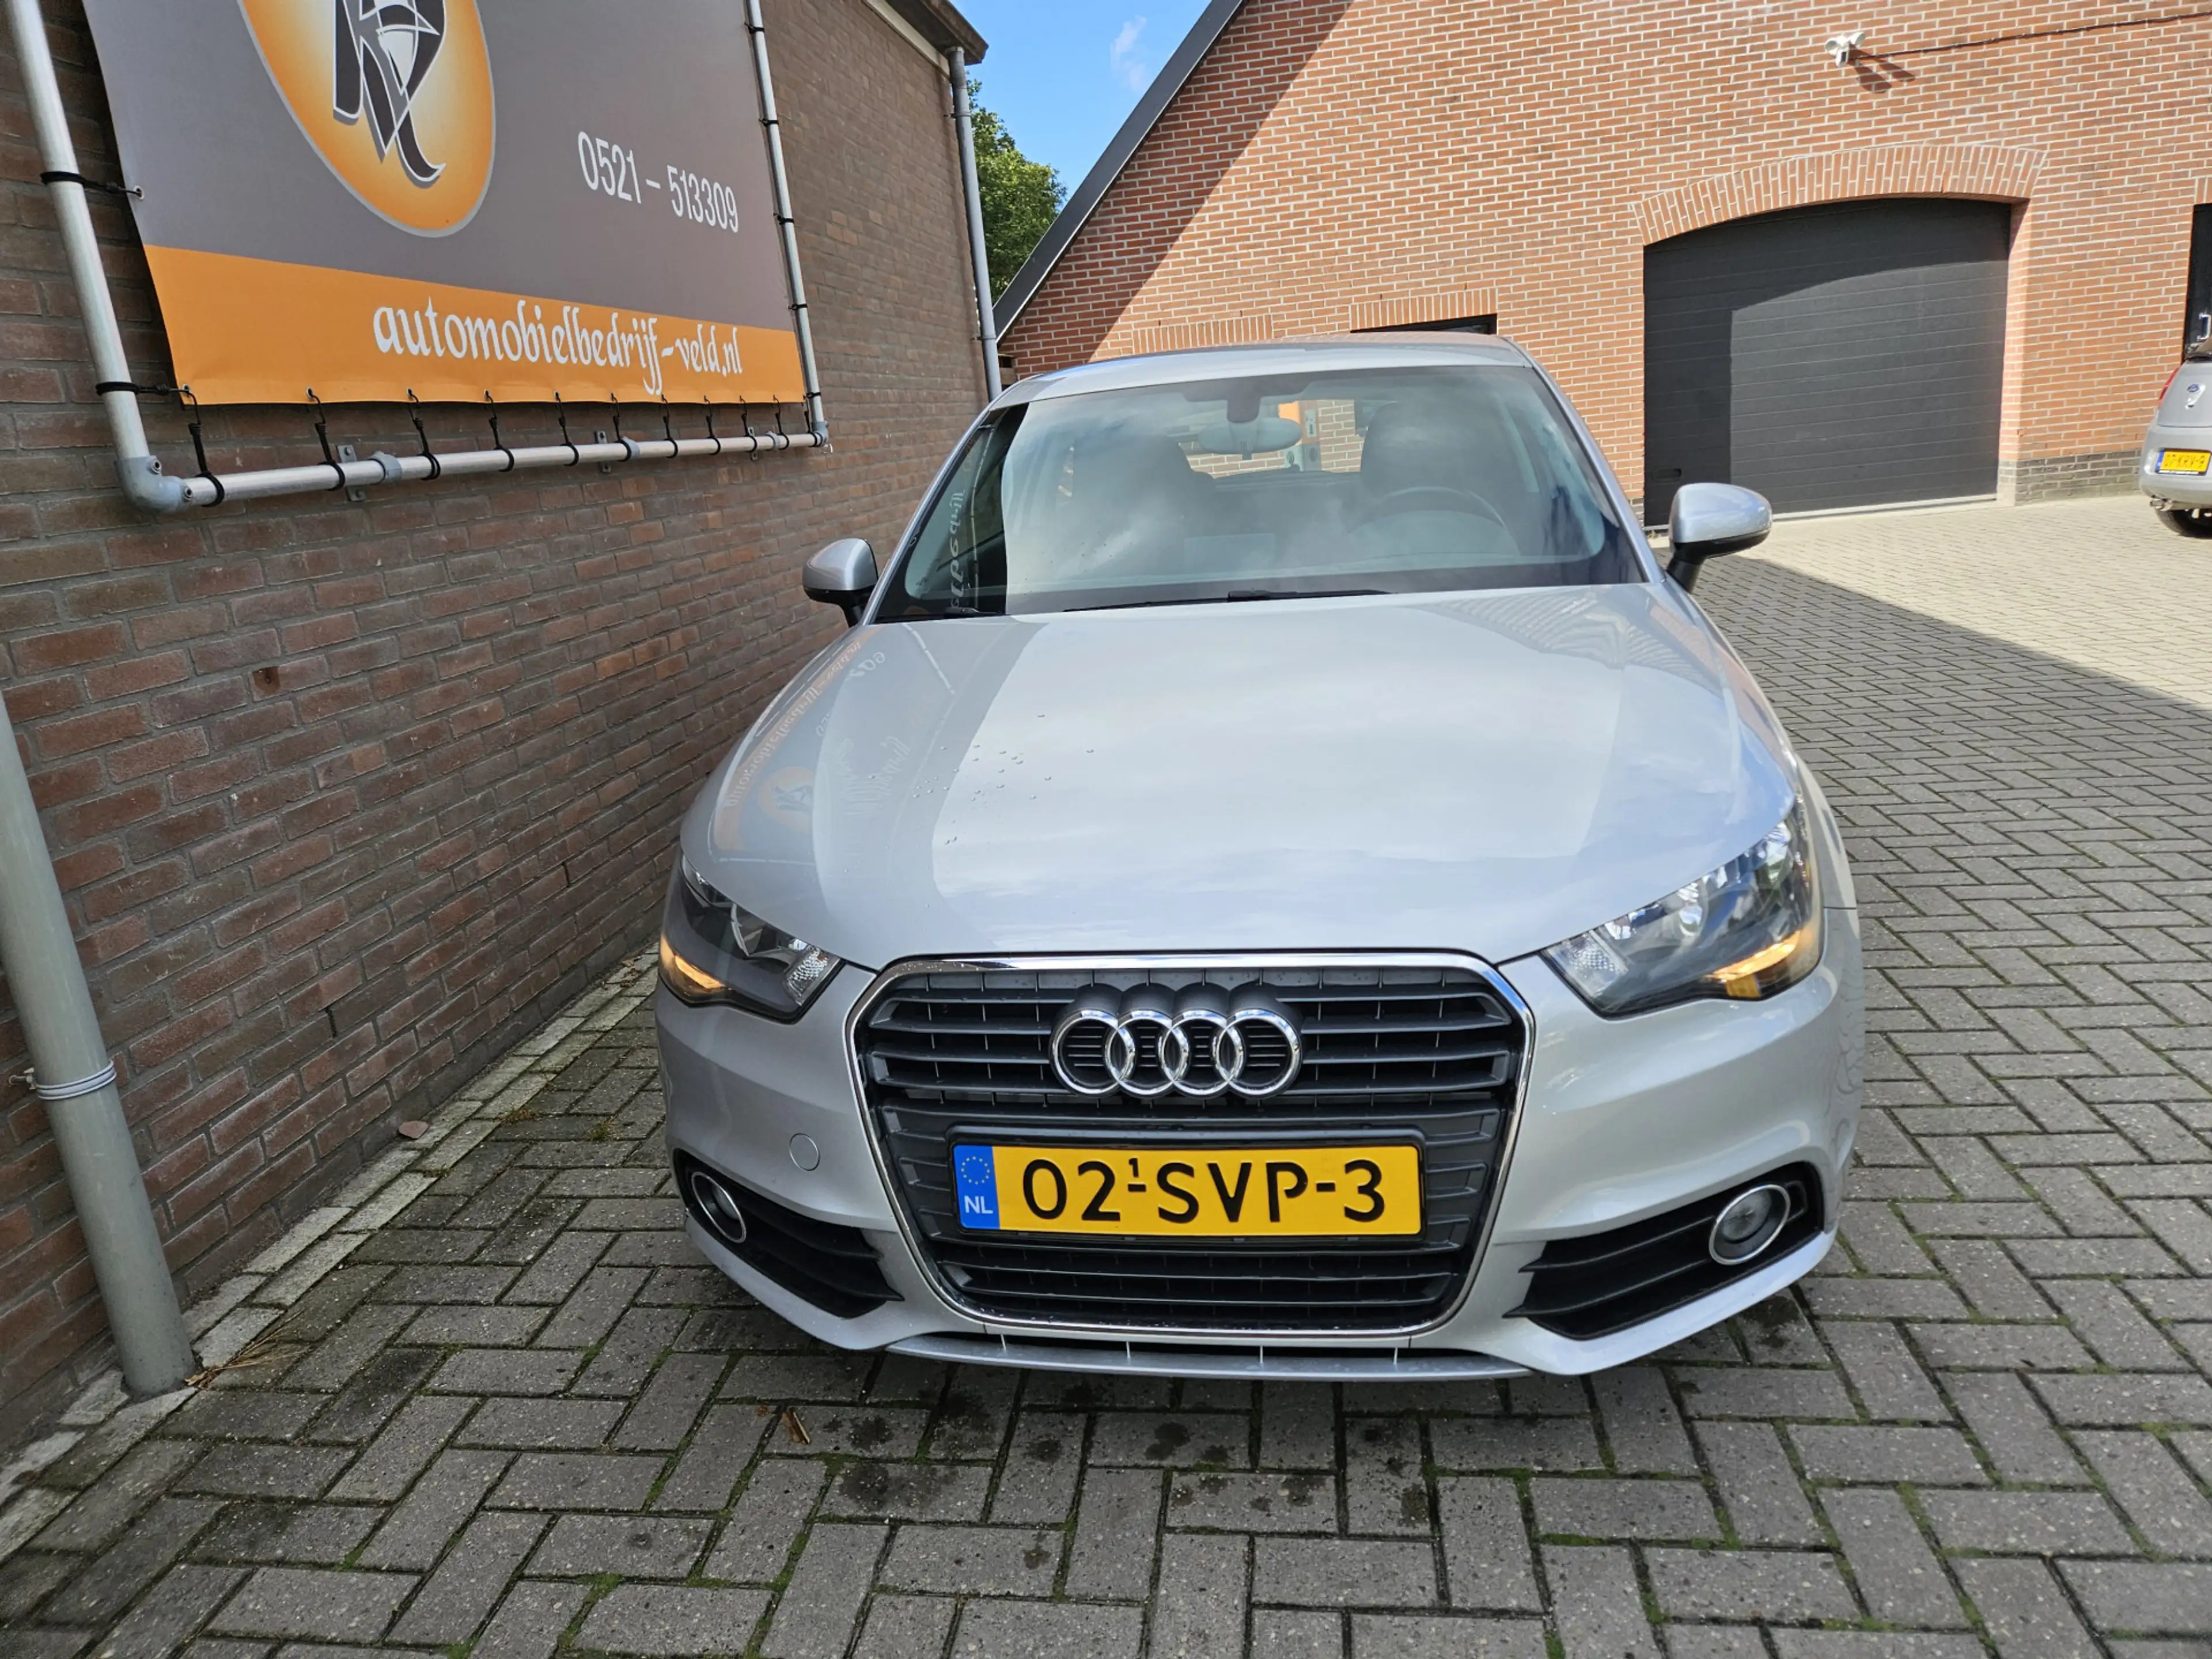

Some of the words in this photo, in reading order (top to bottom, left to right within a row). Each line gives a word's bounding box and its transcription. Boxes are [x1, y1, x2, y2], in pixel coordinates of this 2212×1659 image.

[578, 131, 642, 204] 0521
[666, 164, 739, 233] 513309
[373, 295, 743, 396] automobielbedrijf-veld.nl
[964, 1195, 994, 1214] NL
